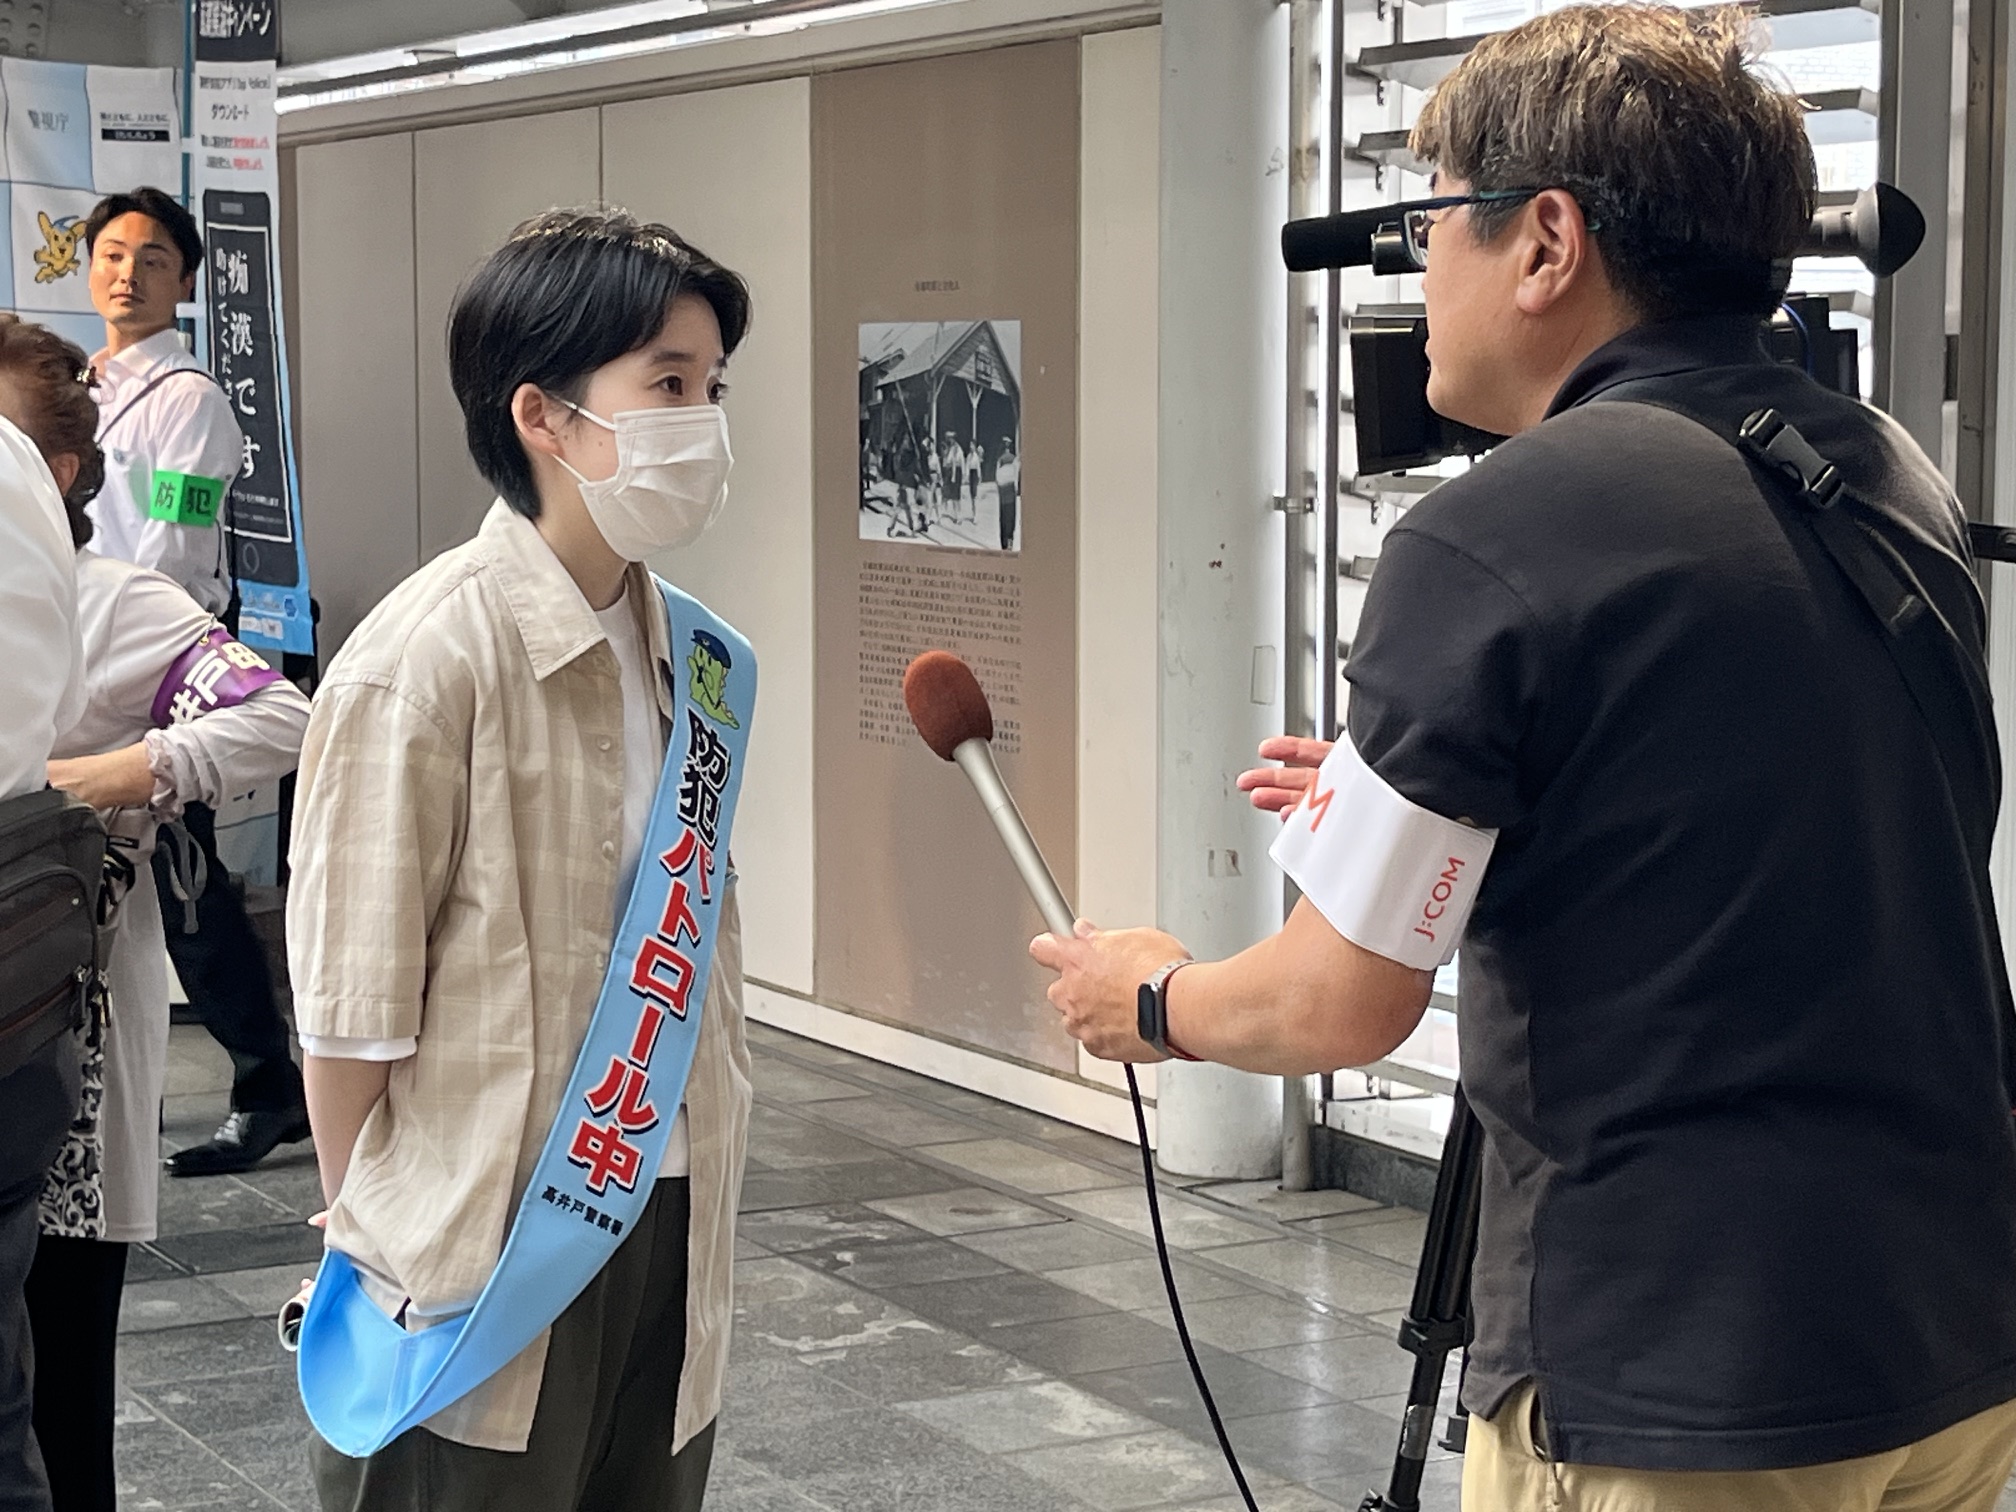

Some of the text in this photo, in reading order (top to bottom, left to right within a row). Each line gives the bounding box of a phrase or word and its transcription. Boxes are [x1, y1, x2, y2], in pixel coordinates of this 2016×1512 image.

[211, 104, 250, 120] ダウンロード
[228, 250, 261, 478] 痴漢です
[154, 480, 212, 516] 防犯
[1414, 856, 1466, 942] J:COM
[566, 705, 732, 1198] 防犯パトロール中
